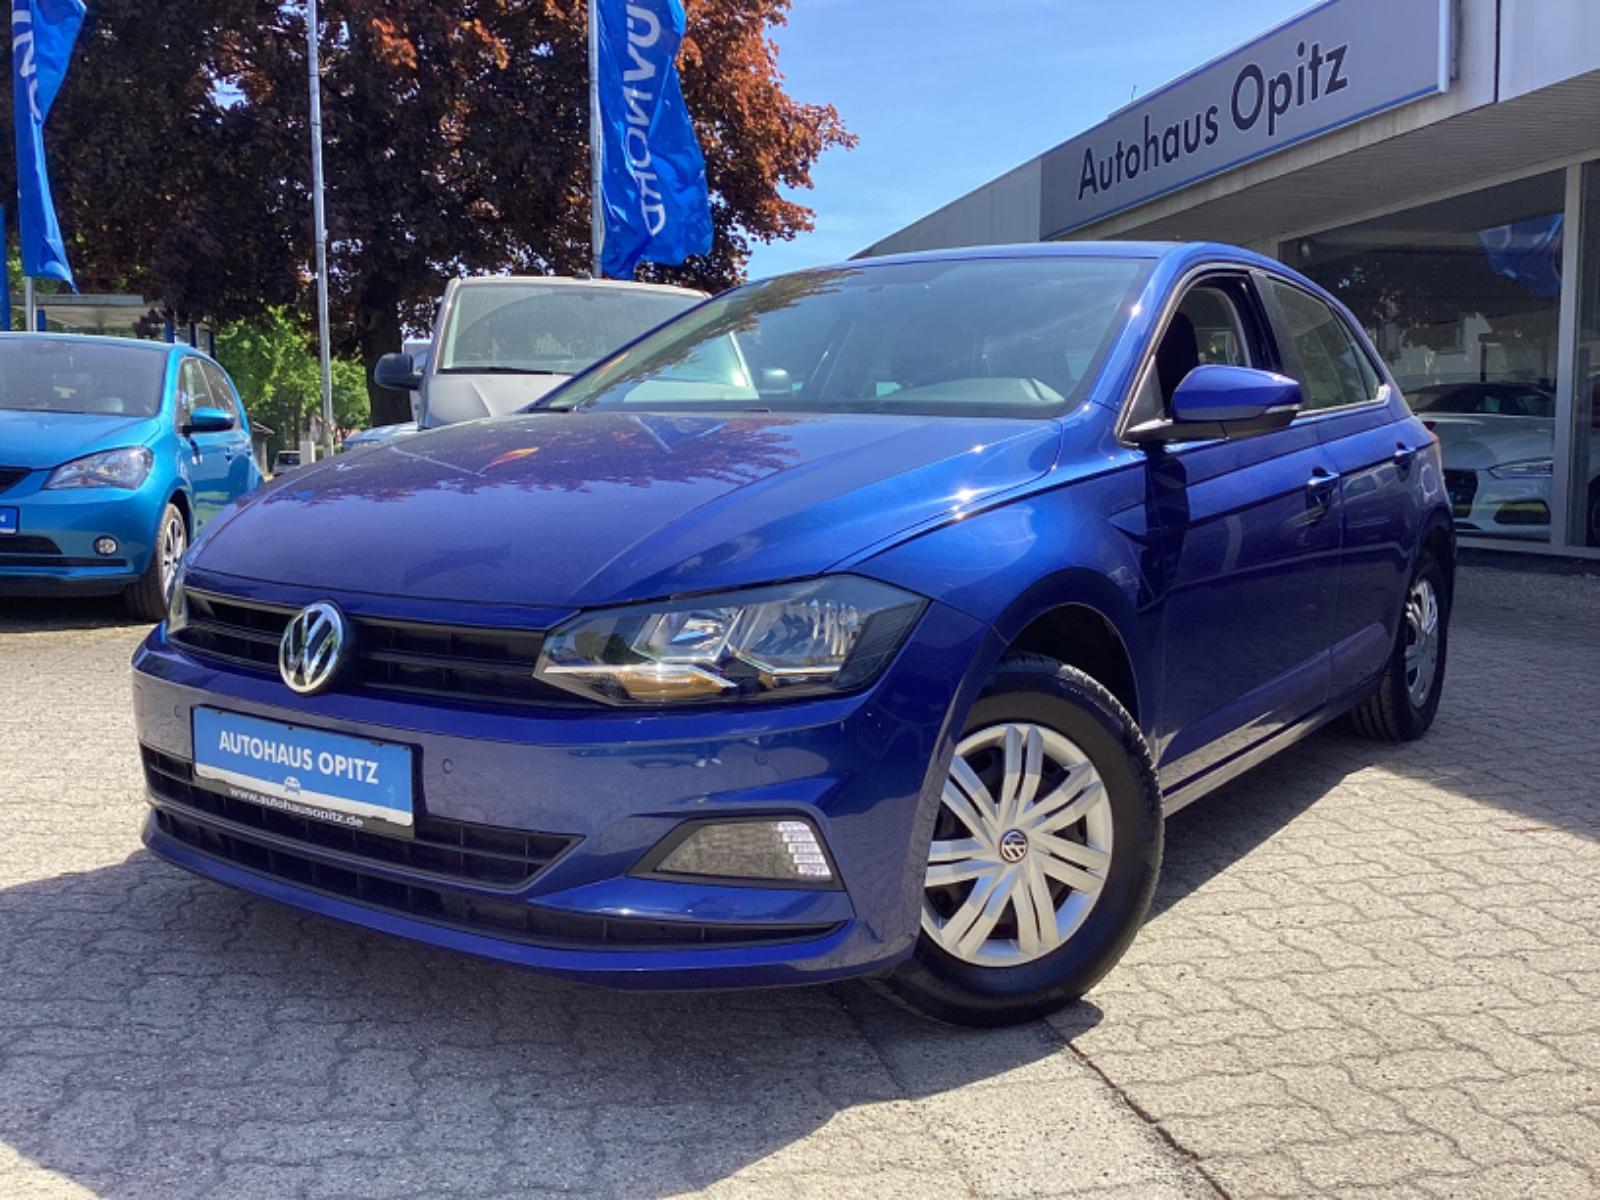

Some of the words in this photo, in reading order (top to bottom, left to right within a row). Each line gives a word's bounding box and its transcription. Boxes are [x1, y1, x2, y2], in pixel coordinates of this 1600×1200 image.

[1078, 105, 1218, 200] Autohaus
[1231, 41, 1348, 136] Opitz
[219, 731, 312, 771] AUTOHAUS
[318, 752, 379, 785] OPITZ
[229, 786, 363, 828] www.autohausopitz.de
